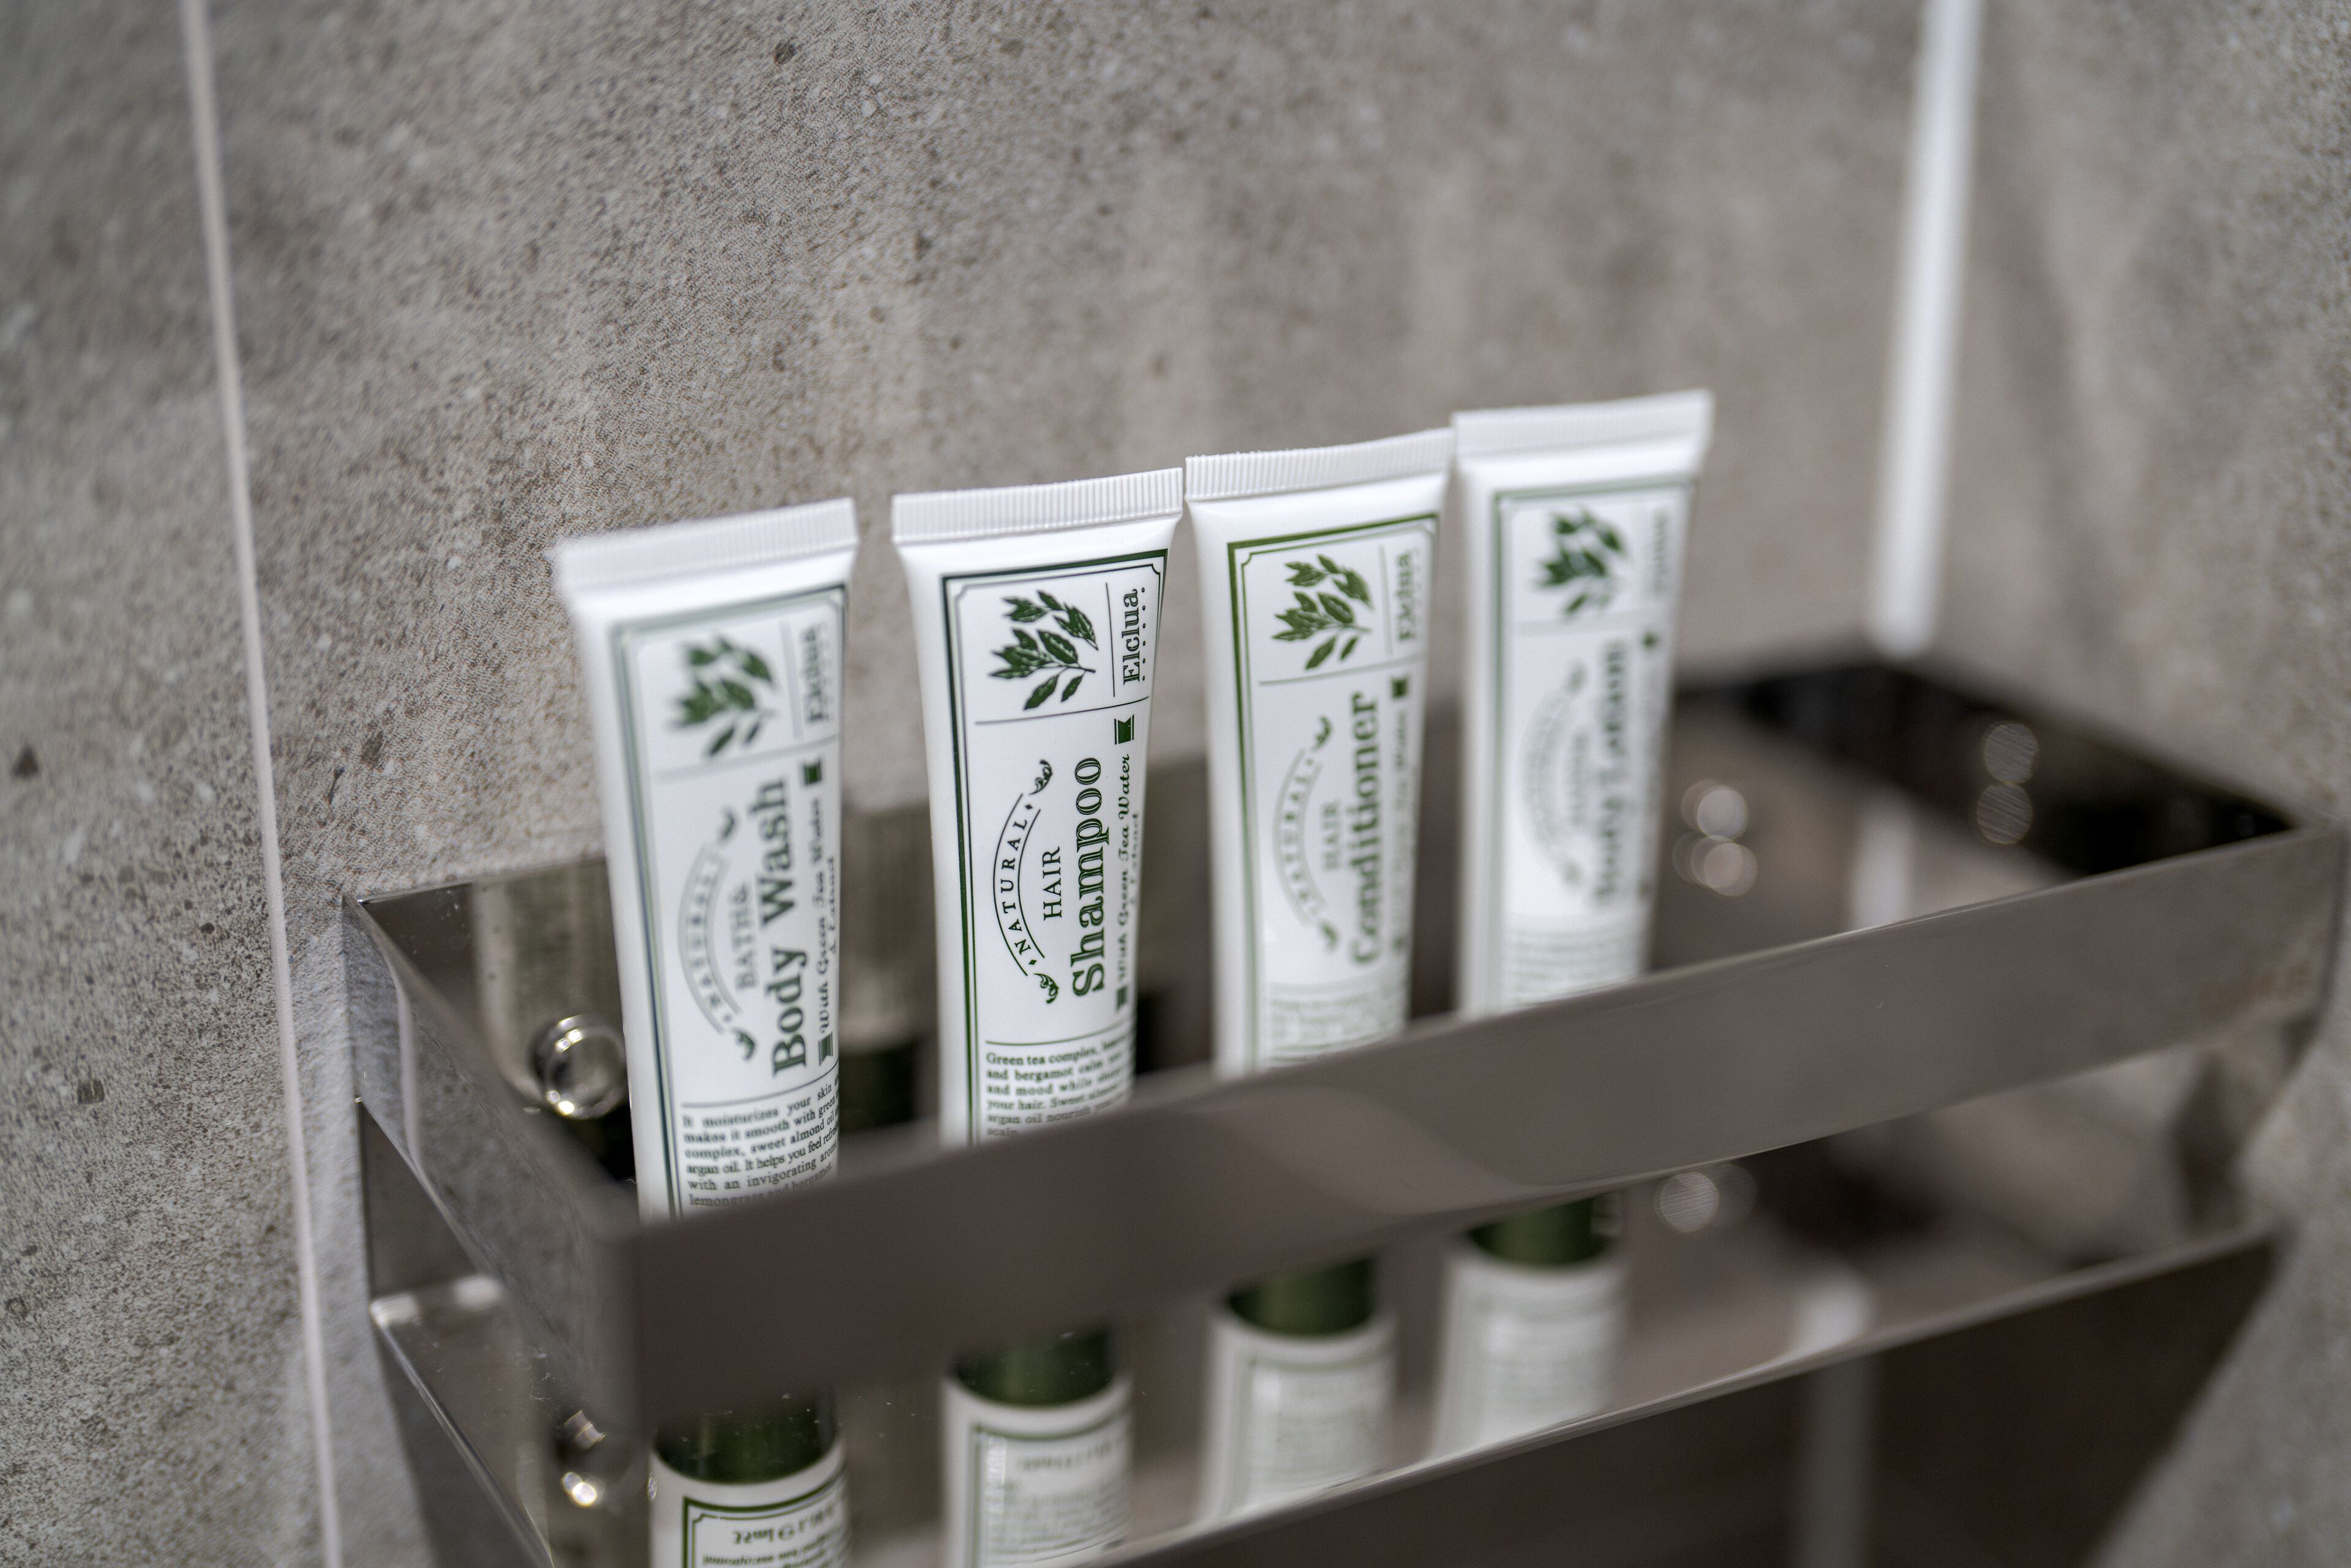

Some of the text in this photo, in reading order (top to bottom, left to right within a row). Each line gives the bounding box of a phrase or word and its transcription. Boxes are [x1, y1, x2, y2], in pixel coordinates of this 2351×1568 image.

[1122, 588, 1140, 685] Elclua
[1118, 754, 1131, 820] Water
[1118, 824, 1130, 863] Tea
[1348, 692, 1380, 964] Conditioner
[1000, 816, 1032, 955] NATURAL
[1043, 846, 1062, 921] HAIR
[1071, 757, 1109, 997] Shampoo
[1117, 868, 1130, 928] Green
[749, 777, 808, 1078] Body Wash
[816, 917, 829, 975] Green
[819, 980, 830, 1034] With
[986, 1052, 1024, 1065] Green
[1027, 1054, 1046, 1065] tea
[986, 1070, 1008, 1081] and
[702, 1108, 779, 1127] moisturizes
[787, 1096, 811, 1116] your
[817, 1082, 832, 1101] skin
[986, 1084, 1010, 1095] and
[1016, 1083, 1054, 1096] mood
[683, 1131, 726, 1143] makes
[730, 1129, 740, 1141] it
[744, 1119, 789, 1138] smooth
[793, 1111, 816, 1127] with
[819, 1096, 836, 1118] green
[750, 1137, 786, 1153] sweet
[790, 1119, 825, 1144] almond
[827, 1110, 835, 1126] oil
[1025, 1114, 1041, 1124] oil
[686, 1163, 720, 1176] argan
[722, 1161, 740, 1173] oil.
[745, 1159, 756, 1171] It
[757, 1153, 786, 1171] helps
[787, 1146, 806, 1165] you
[808, 1138, 822, 1154] feel
[686, 1177, 717, 1190] with
[724, 1179, 740, 1190] an
[746, 1157, 817, 1187] invigorating
